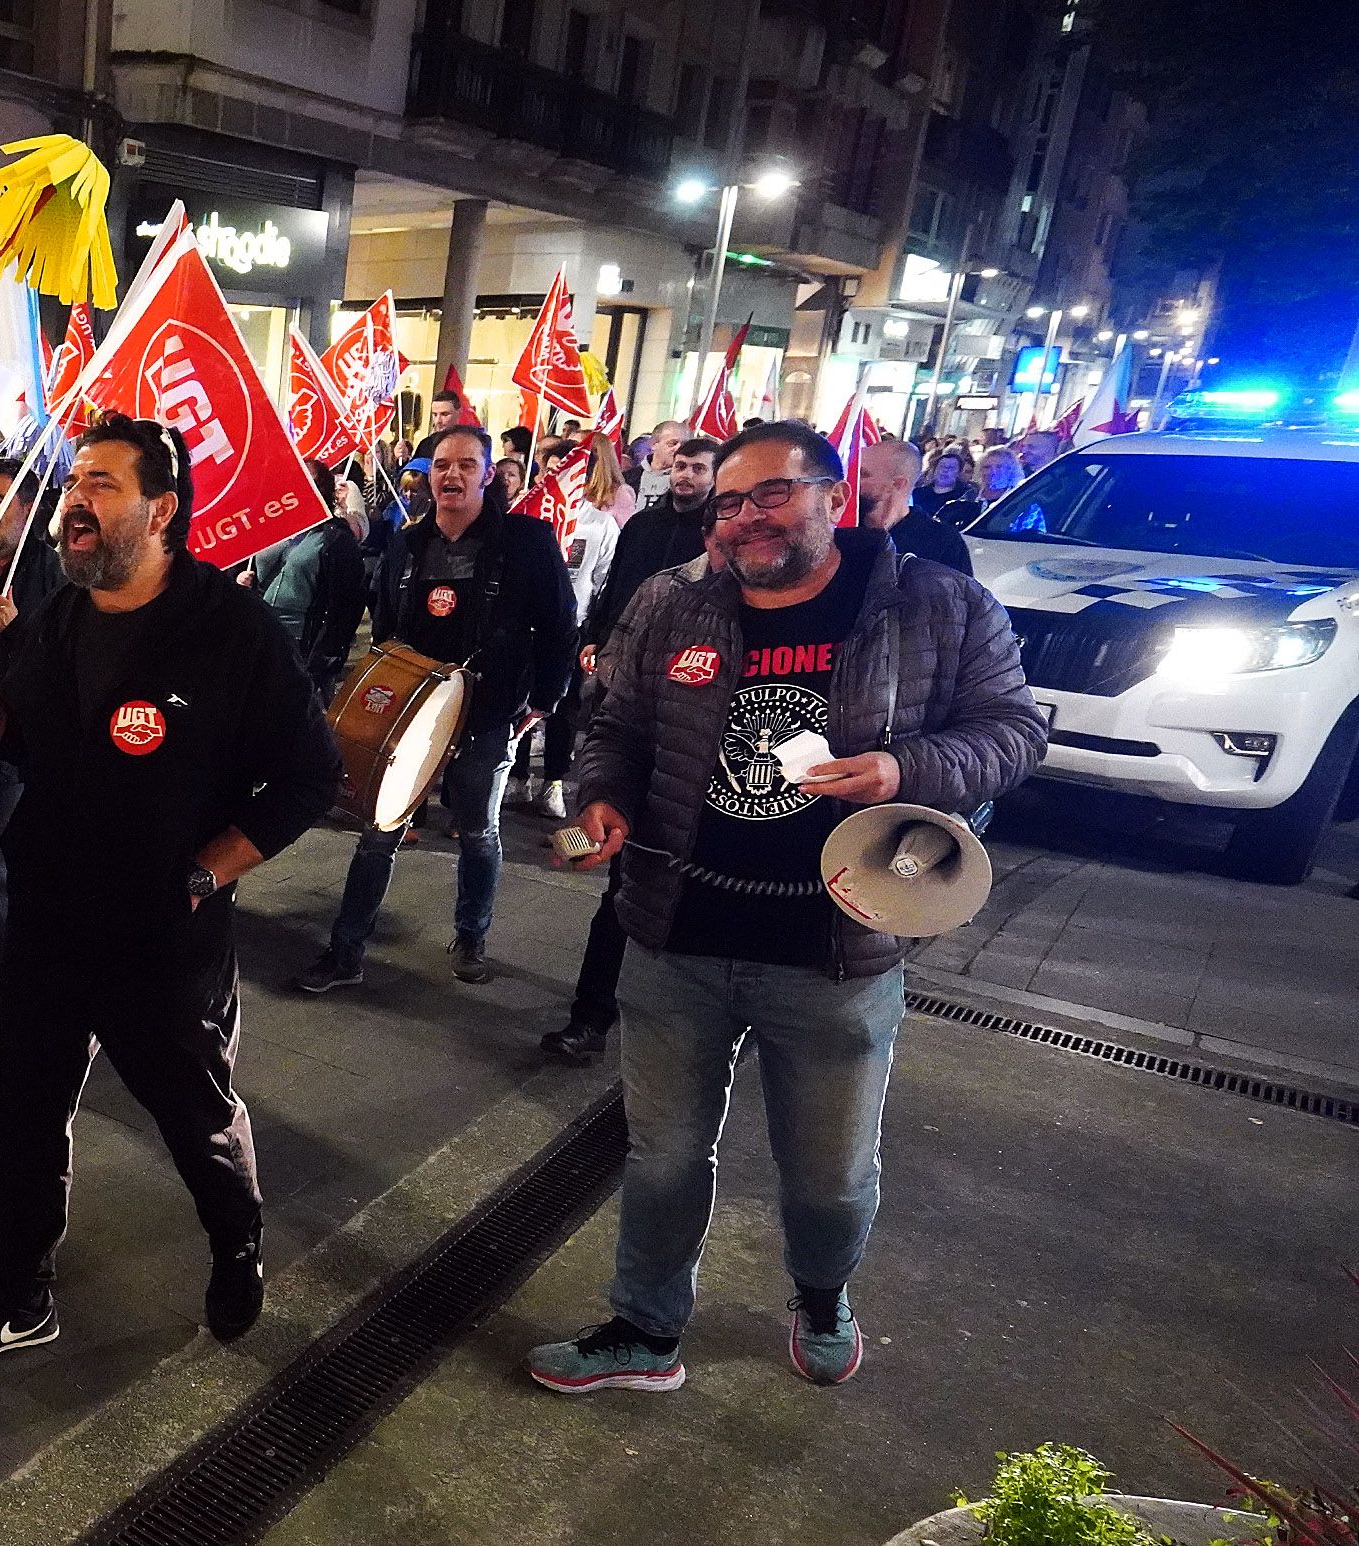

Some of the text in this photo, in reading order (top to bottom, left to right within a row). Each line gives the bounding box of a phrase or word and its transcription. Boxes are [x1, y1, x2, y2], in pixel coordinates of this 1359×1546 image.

[162, 335, 235, 467] UGT
[678, 650, 717, 670] UGT
[739, 688, 800, 706] PULPO
[117, 706, 157, 728] UGT
[715, 792, 814, 816] MIENTOS
